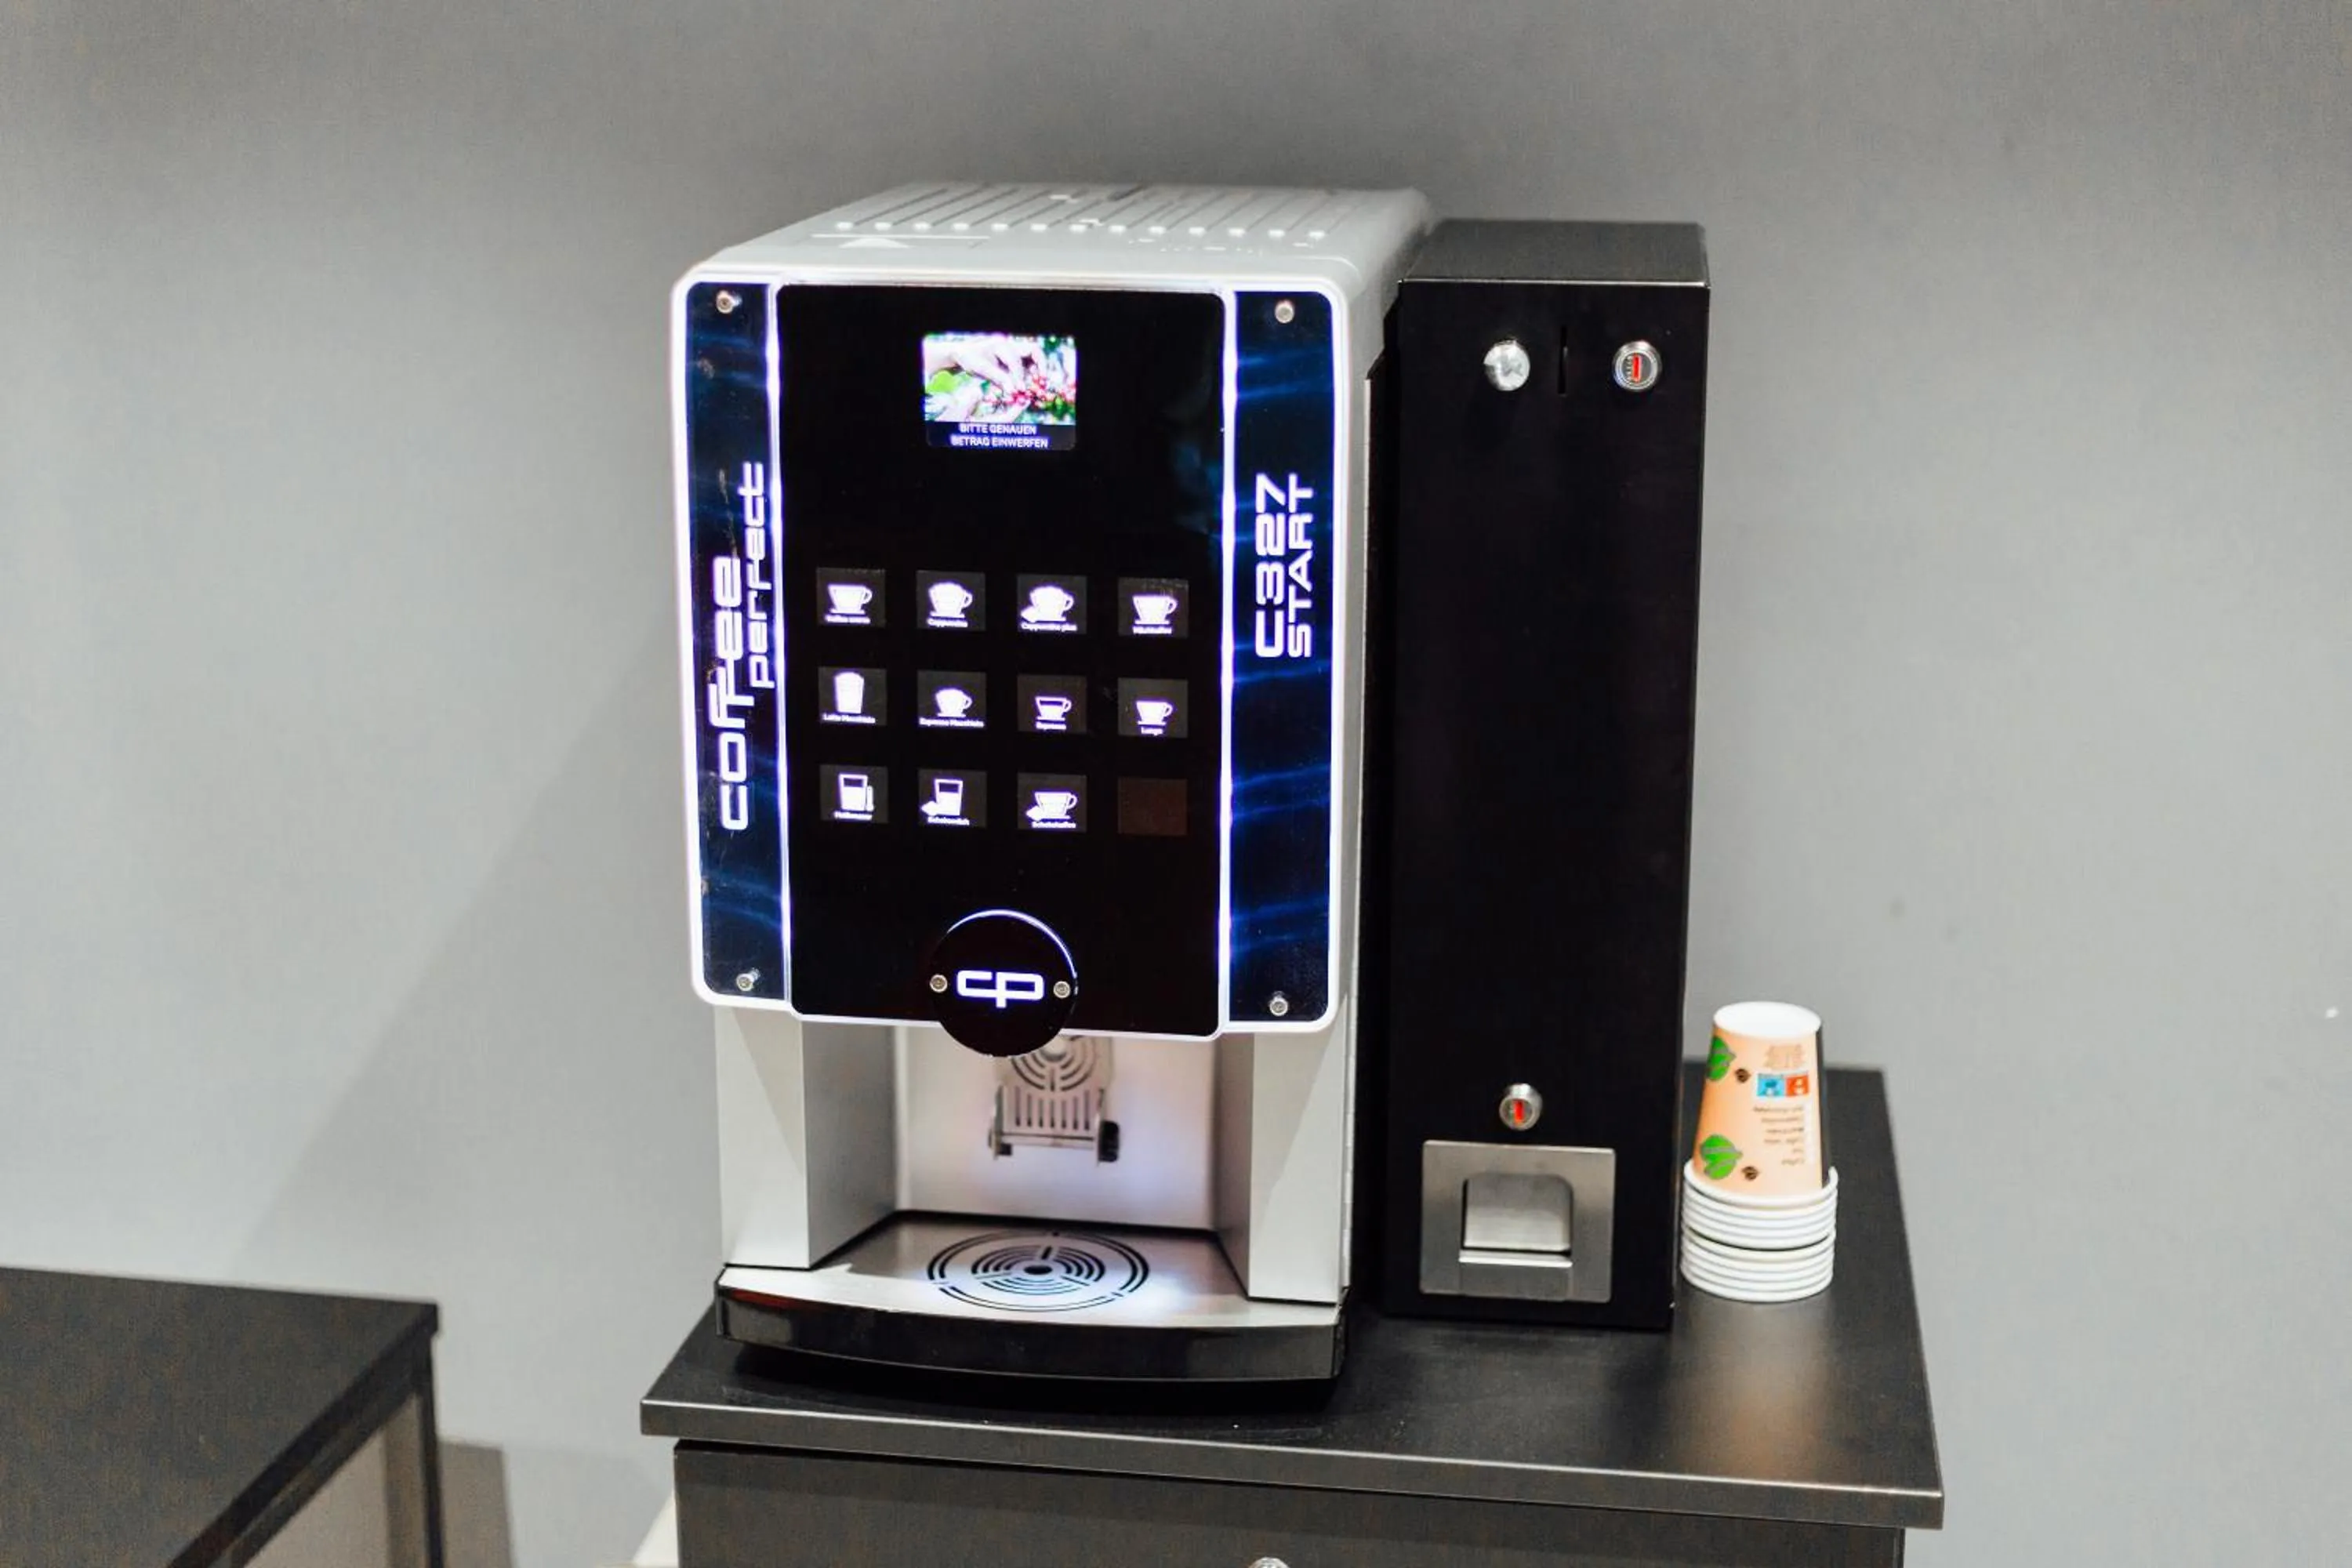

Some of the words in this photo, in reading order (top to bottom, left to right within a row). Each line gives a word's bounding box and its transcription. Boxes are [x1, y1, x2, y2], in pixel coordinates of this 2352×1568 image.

[950, 434, 990, 447] BETRAG
[992, 437, 1049, 449] EINWERFEN
[959, 423, 988, 434] BITTE
[989, 423, 1037, 435] GENAUEN
[737, 461, 775, 689] perfect
[1255, 473, 1287, 658] C327
[1287, 473, 1314, 658] START
[956, 970, 1044, 1008] cp
